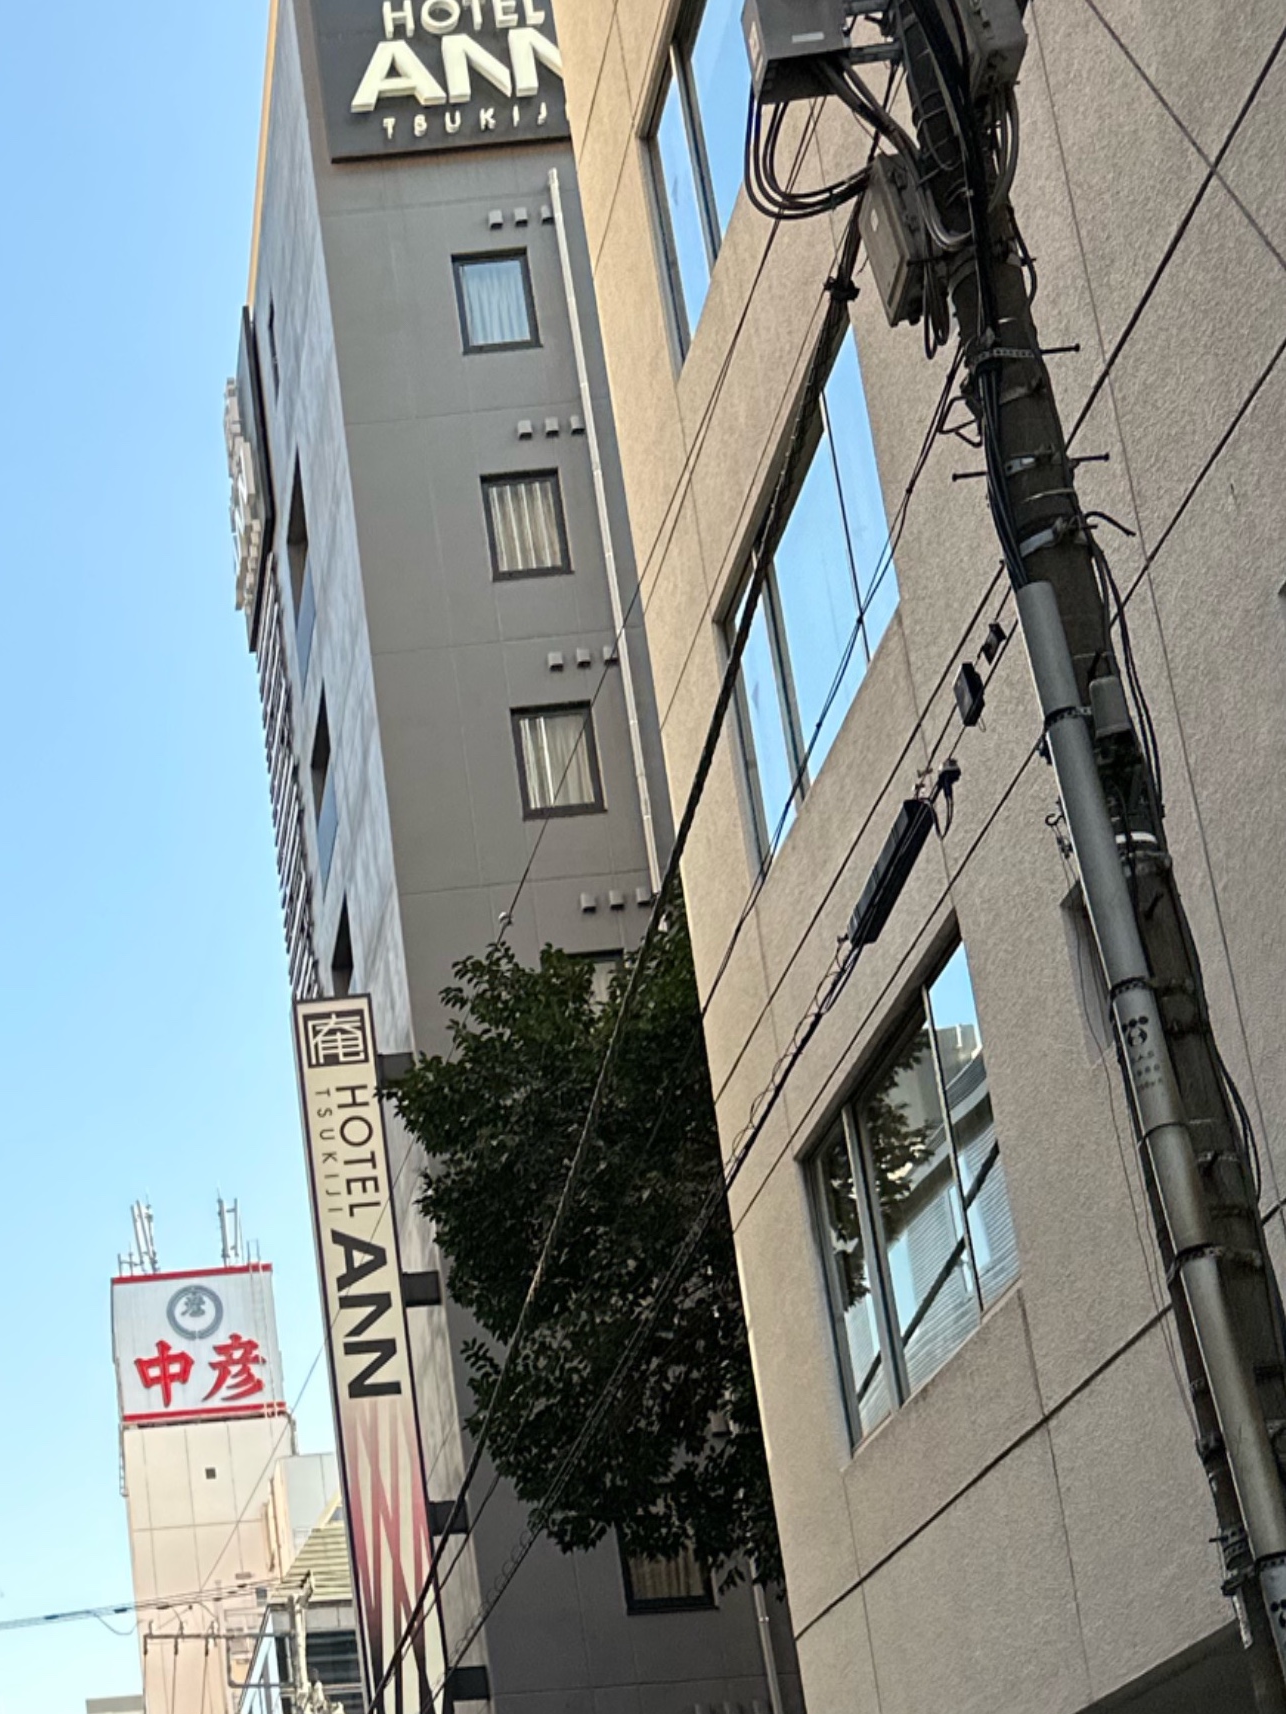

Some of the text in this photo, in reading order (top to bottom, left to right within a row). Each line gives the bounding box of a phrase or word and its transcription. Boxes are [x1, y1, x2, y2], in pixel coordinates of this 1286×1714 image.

[382, 0, 545, 39] HOTEL
[383, 102, 568, 139] TSUKIJ
[315, 1087, 343, 1213] TSUKIJI
[331, 1084, 401, 1398] HOTEL ANN
[134, 1333, 266, 1408] 中彦
